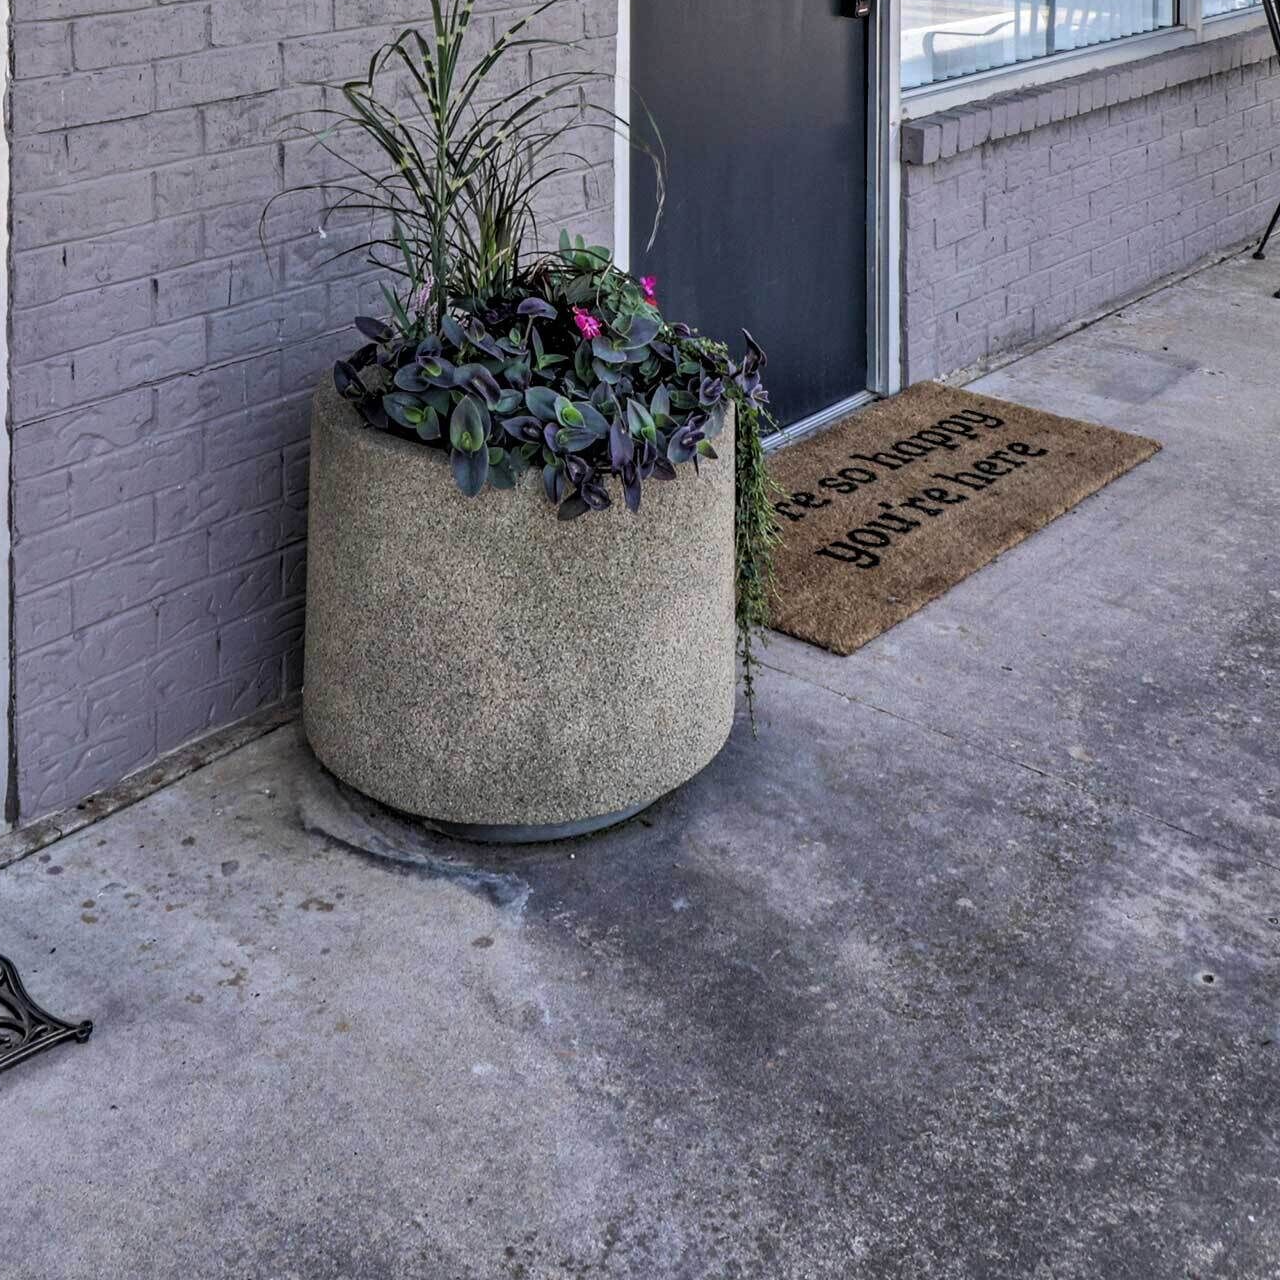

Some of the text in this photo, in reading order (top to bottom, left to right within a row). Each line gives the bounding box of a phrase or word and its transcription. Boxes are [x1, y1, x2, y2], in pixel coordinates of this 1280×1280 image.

[814, 439, 1049, 569] you're here
[818, 467, 878, 494] so
[849, 408, 1005, 471] happy
